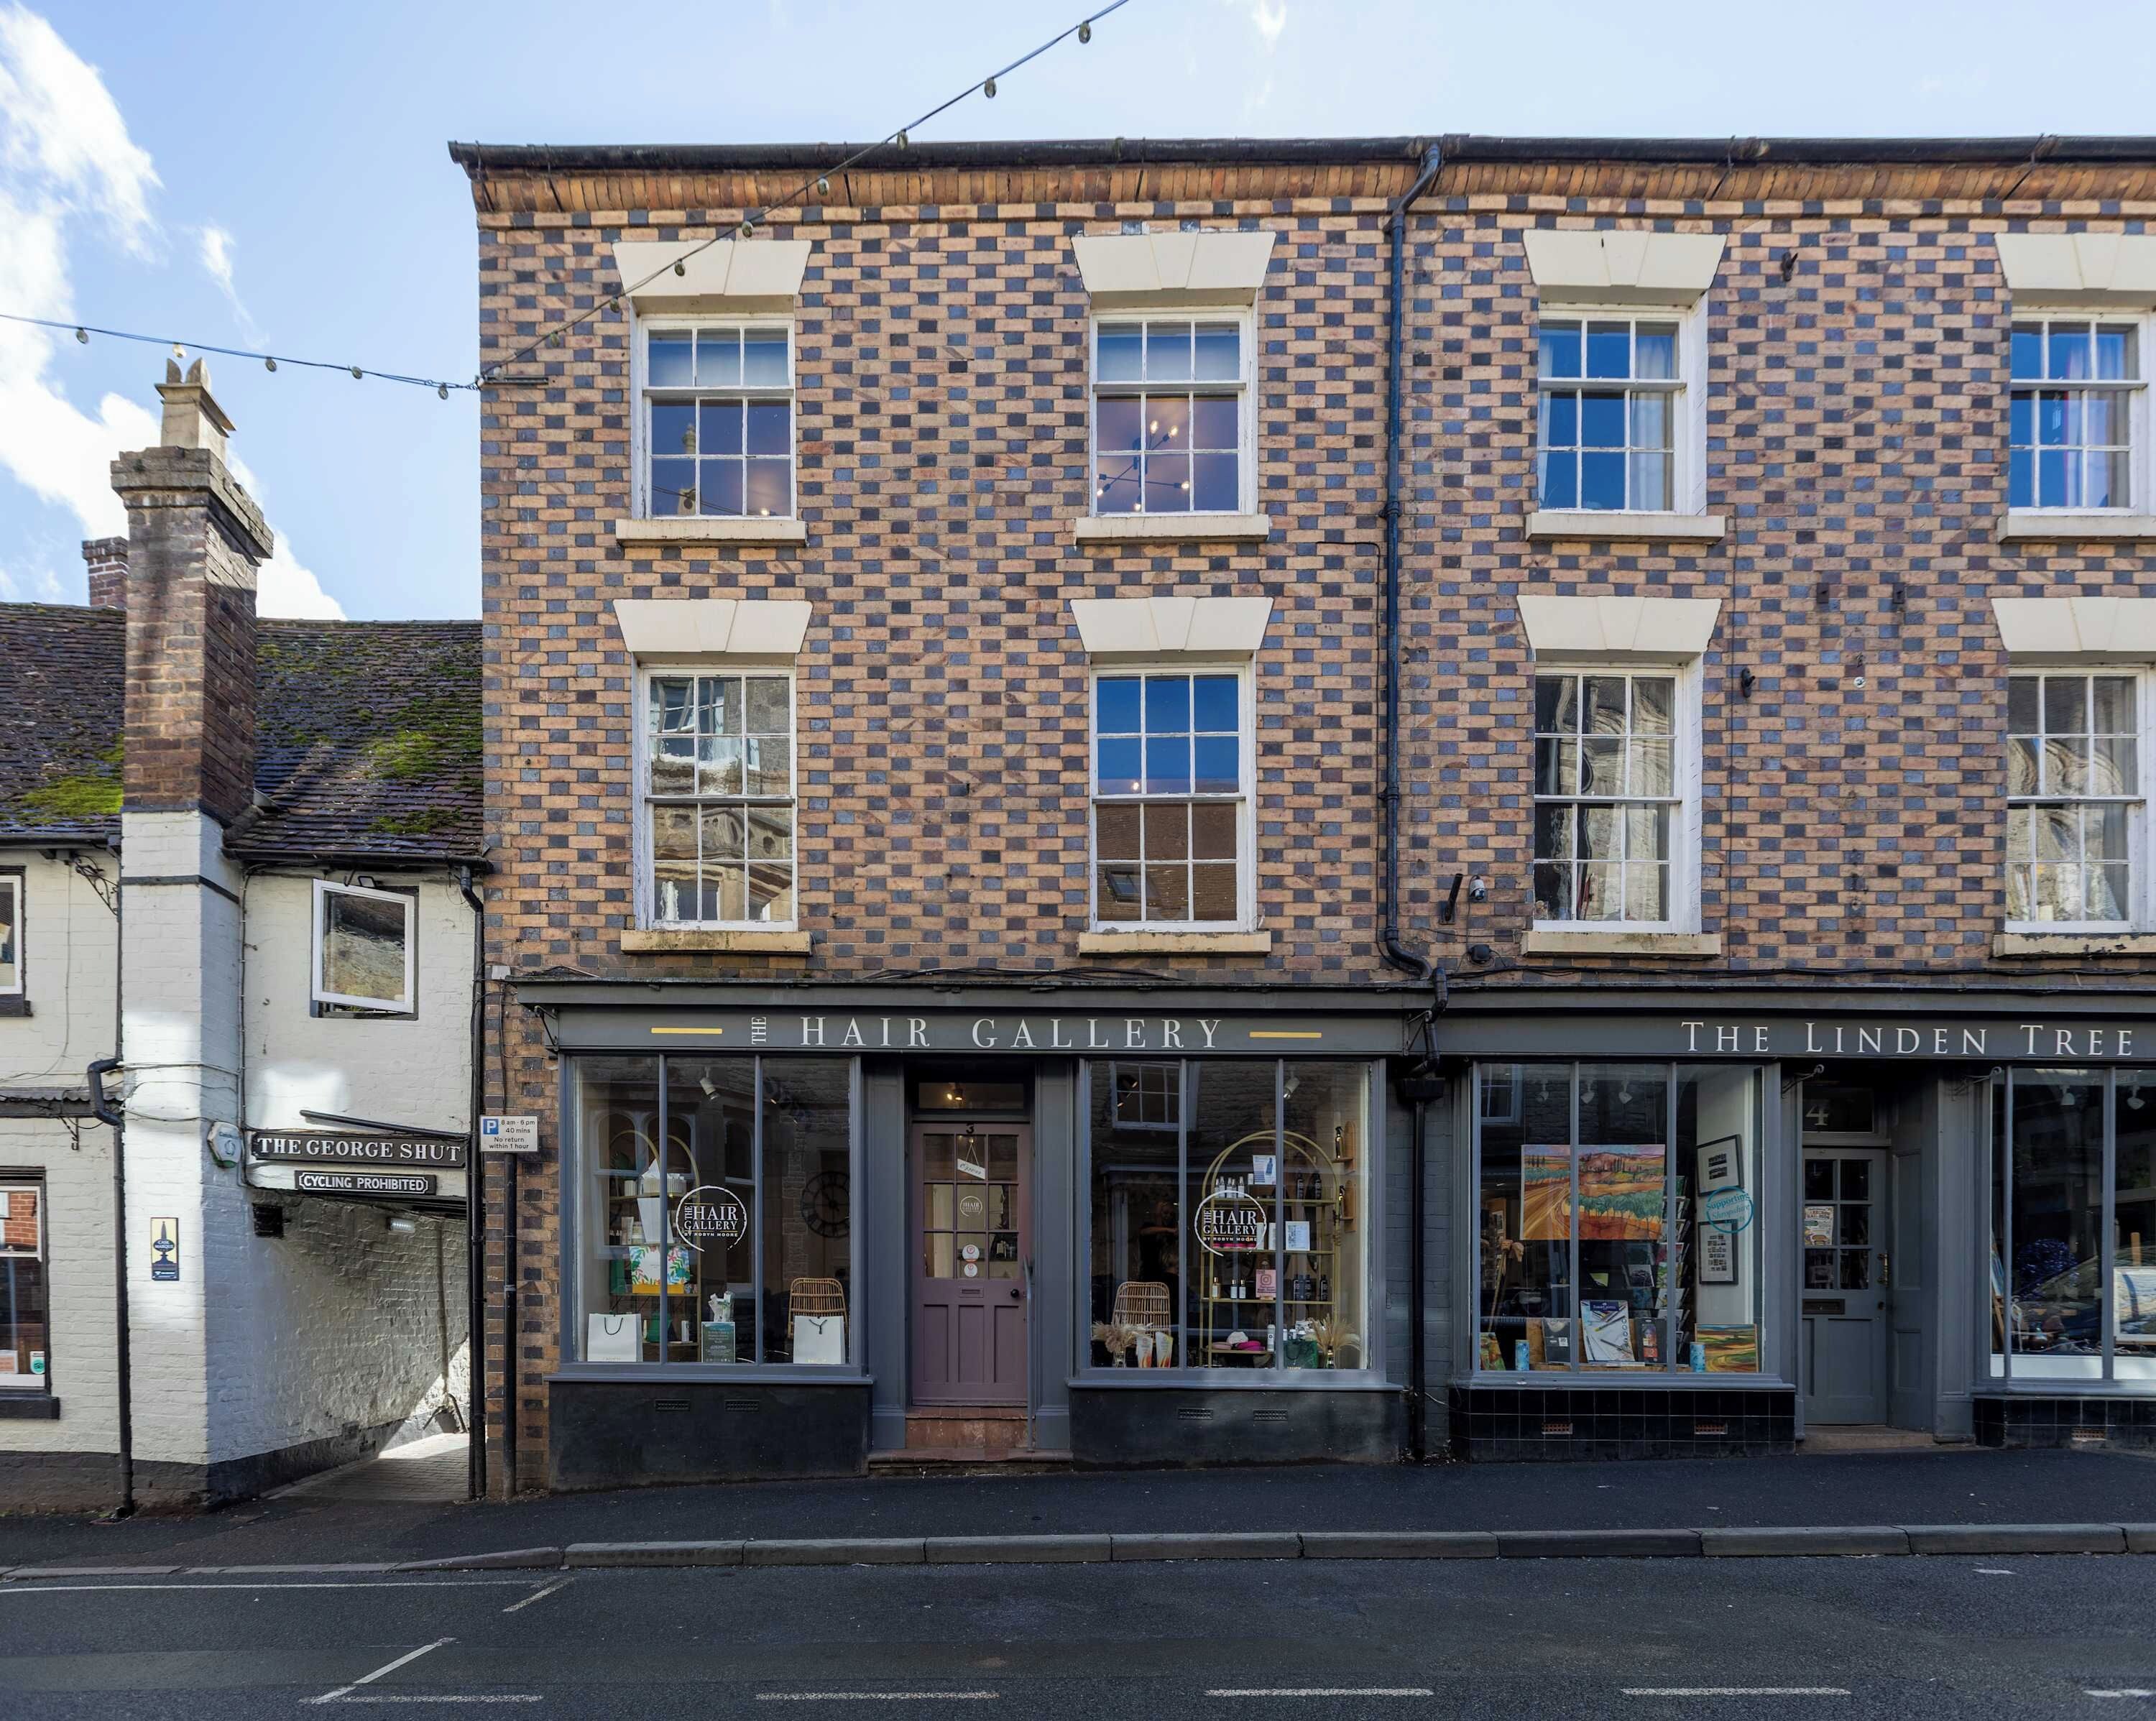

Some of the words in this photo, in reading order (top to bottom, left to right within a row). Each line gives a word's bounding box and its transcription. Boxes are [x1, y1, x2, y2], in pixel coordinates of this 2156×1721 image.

[751, 1017, 767, 1045] THE
[800, 1017, 930, 1047] HAIR
[972, 1018, 1222, 1048] GALLERY
[1681, 1021, 1769, 1051] THE
[1805, 1023, 1989, 1054] LINDEN
[2019, 1025, 2133, 1056] TREE
[1805, 1103, 1829, 1126] 4
[487, 1120, 497, 1133] P
[966, 1122, 975, 1134] 3
[257, 1138, 301, 1155] THE
[306, 1140, 394, 1158] GEORGE
[400, 1143, 461, 1161] SHUT
[303, 1174, 352, 1189] CYCLING
[356, 1176, 425, 1191] PROHIBITED
[1707, 1193, 1750, 1209] Supporting
[684, 1205, 693, 1220] THE
[693, 1206, 739, 1220] HAIR
[1203, 1209, 1212, 1224] THE
[1212, 1210, 1257, 1225] HAIR
[1713, 1205, 1749, 1219] Shropshire
[683, 1220, 738, 1230] GALLERY
[1203, 1224, 1258, 1235] GALLERY
